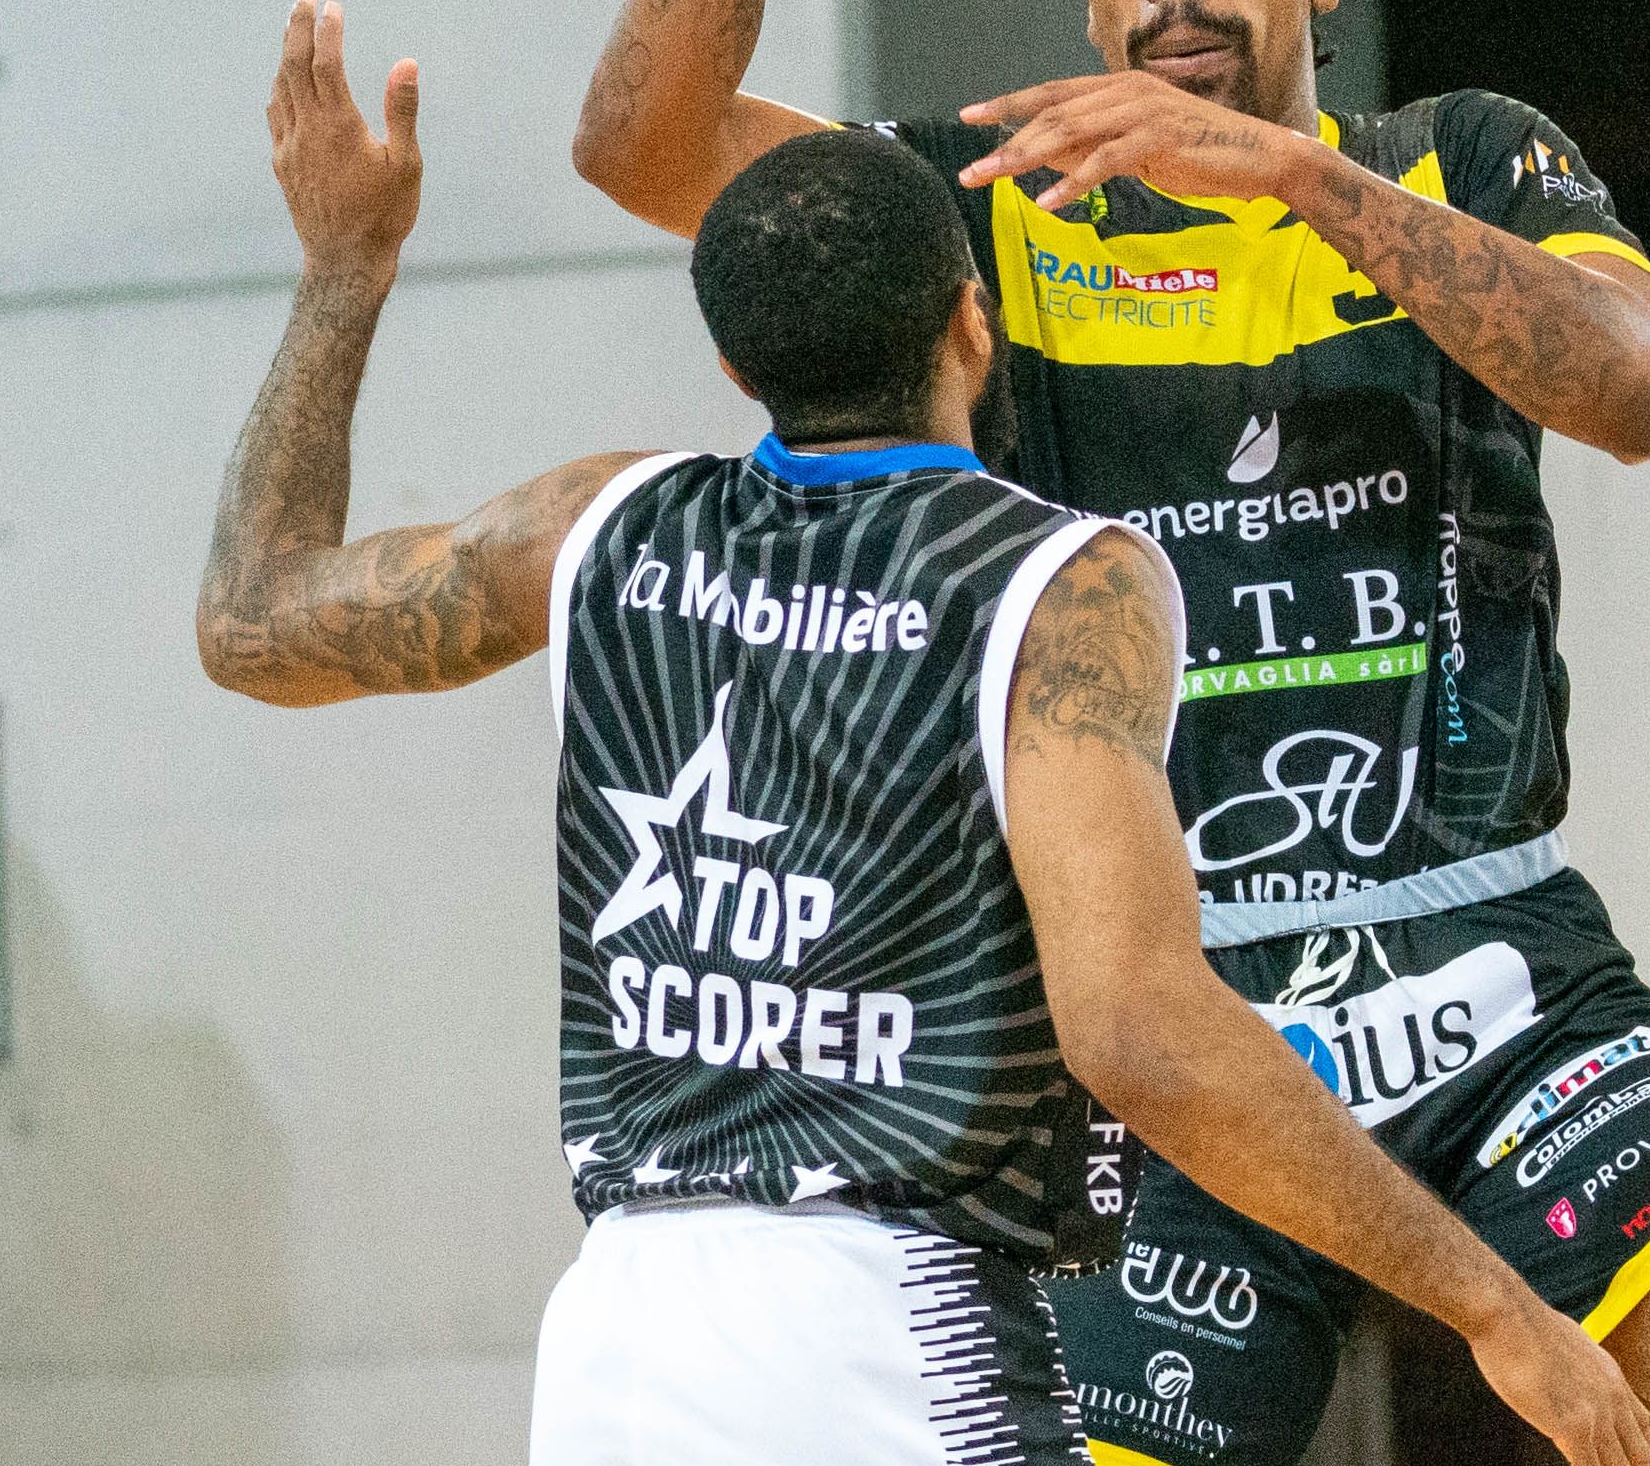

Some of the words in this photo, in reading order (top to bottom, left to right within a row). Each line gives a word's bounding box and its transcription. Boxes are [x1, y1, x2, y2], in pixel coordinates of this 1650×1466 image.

[1030, 241, 1114, 291] RAU
[1118, 268, 1216, 292] Miele
[1038, 287, 1216, 328] ECTRICITE
[618, 543, 671, 611] la
[693, 855, 836, 967] TOP
[609, 955, 914, 1088] SCORER
[1086, 1121, 1125, 1215] FKB
[1135, 1306, 1179, 1331] Conseils
[1180, 1321, 1196, 1334] en
[1195, 1326, 1247, 1352] personnel
[1076, 1381, 1234, 1459] monthey
[1084, 1411, 1122, 1429] ILLE
